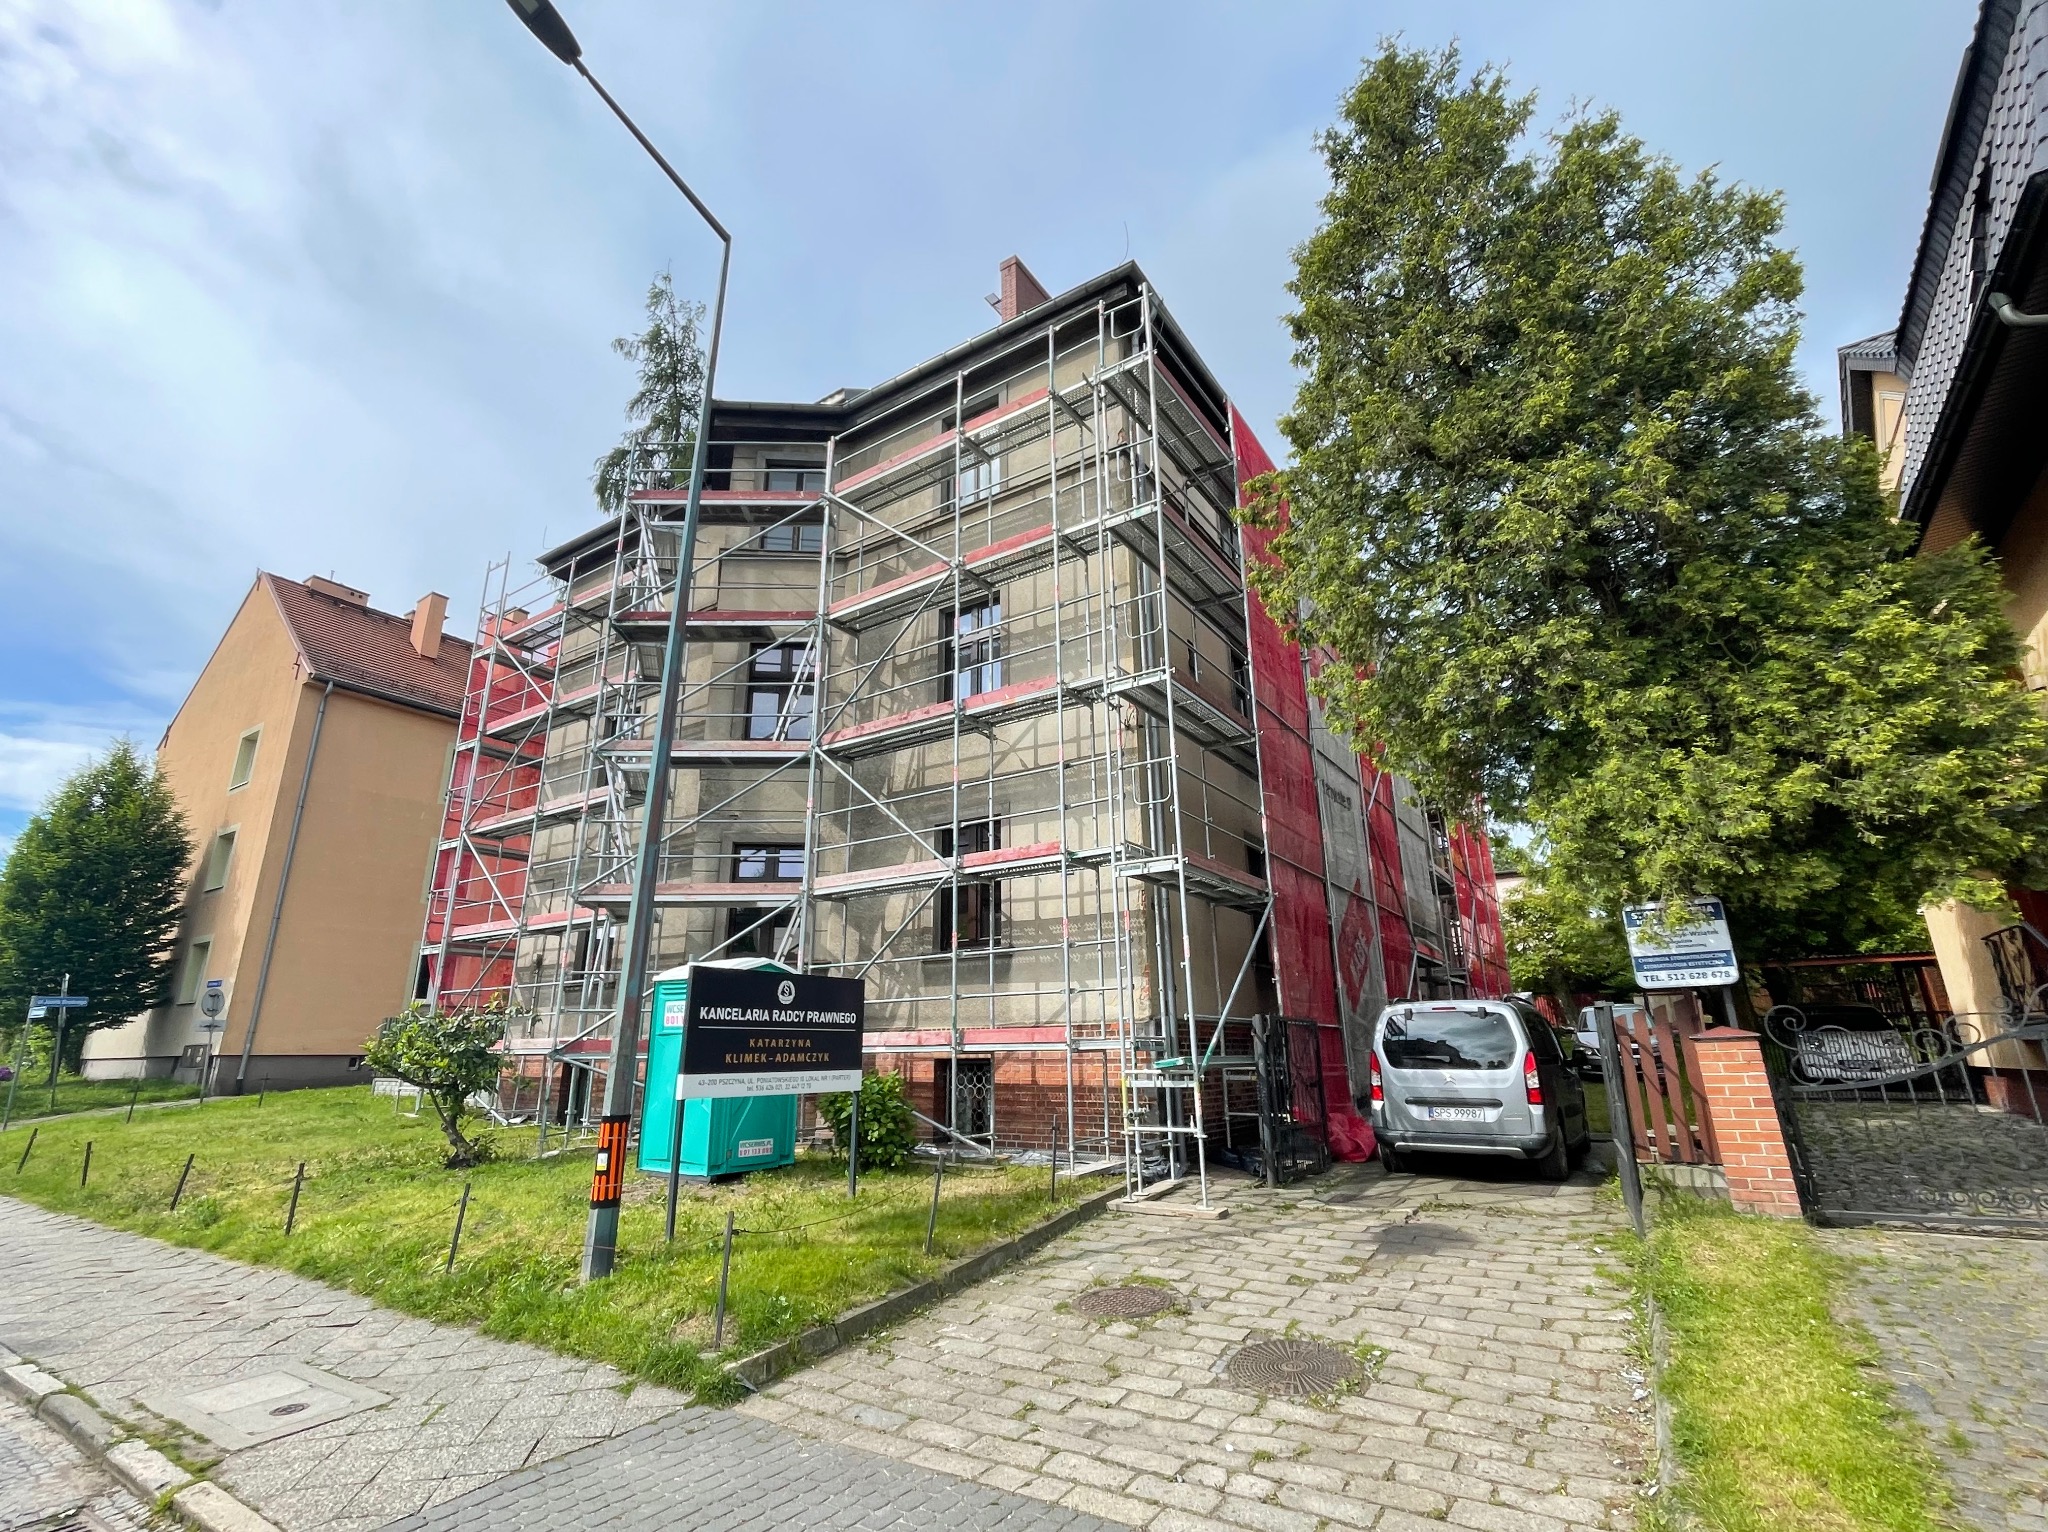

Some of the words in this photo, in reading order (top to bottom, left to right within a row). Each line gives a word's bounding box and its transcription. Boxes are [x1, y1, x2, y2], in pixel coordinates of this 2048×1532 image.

[1643, 974, 1665, 983] TEL.
[1667, 973, 1686, 982] 512
[1689, 972, 1708, 980] 628
[1711, 970, 1731, 978] 678
[700, 1006, 769, 1021] KANCELARIA
[772, 1009, 806, 1023] RADCY
[806, 1011, 857, 1024] PRAWNEGO
[749, 1038, 811, 1048] KATARZYNA
[725, 1052, 830, 1064] KLIMEK-ADAMCZYK
[1434, 1108, 1452, 1118] SPS
[1454, 1108, 1483, 1119] 99987
